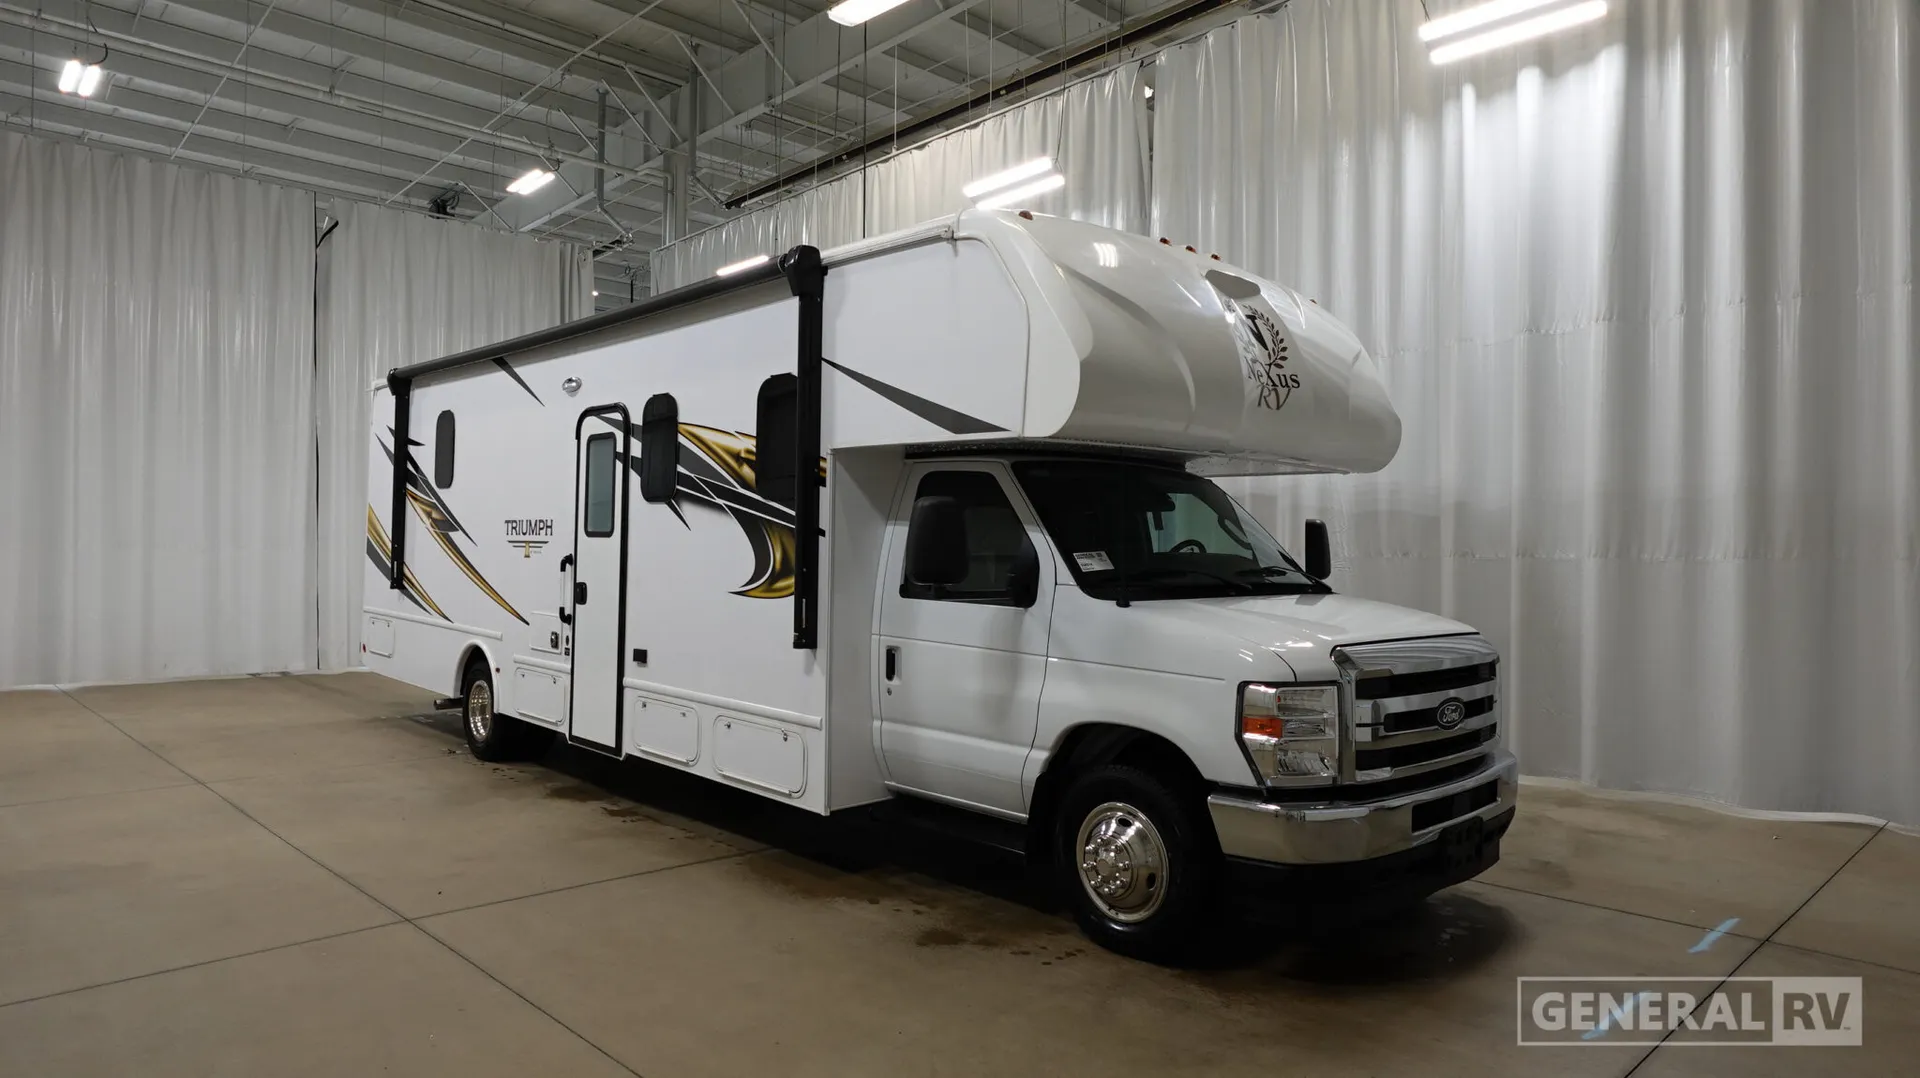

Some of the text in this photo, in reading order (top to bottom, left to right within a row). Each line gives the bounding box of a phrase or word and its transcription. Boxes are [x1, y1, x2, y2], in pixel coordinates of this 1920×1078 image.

[1256, 385, 1292, 411] RV
[504, 519, 554, 537] TRIUMPH
[1442, 705, 1461, 722] Ford
